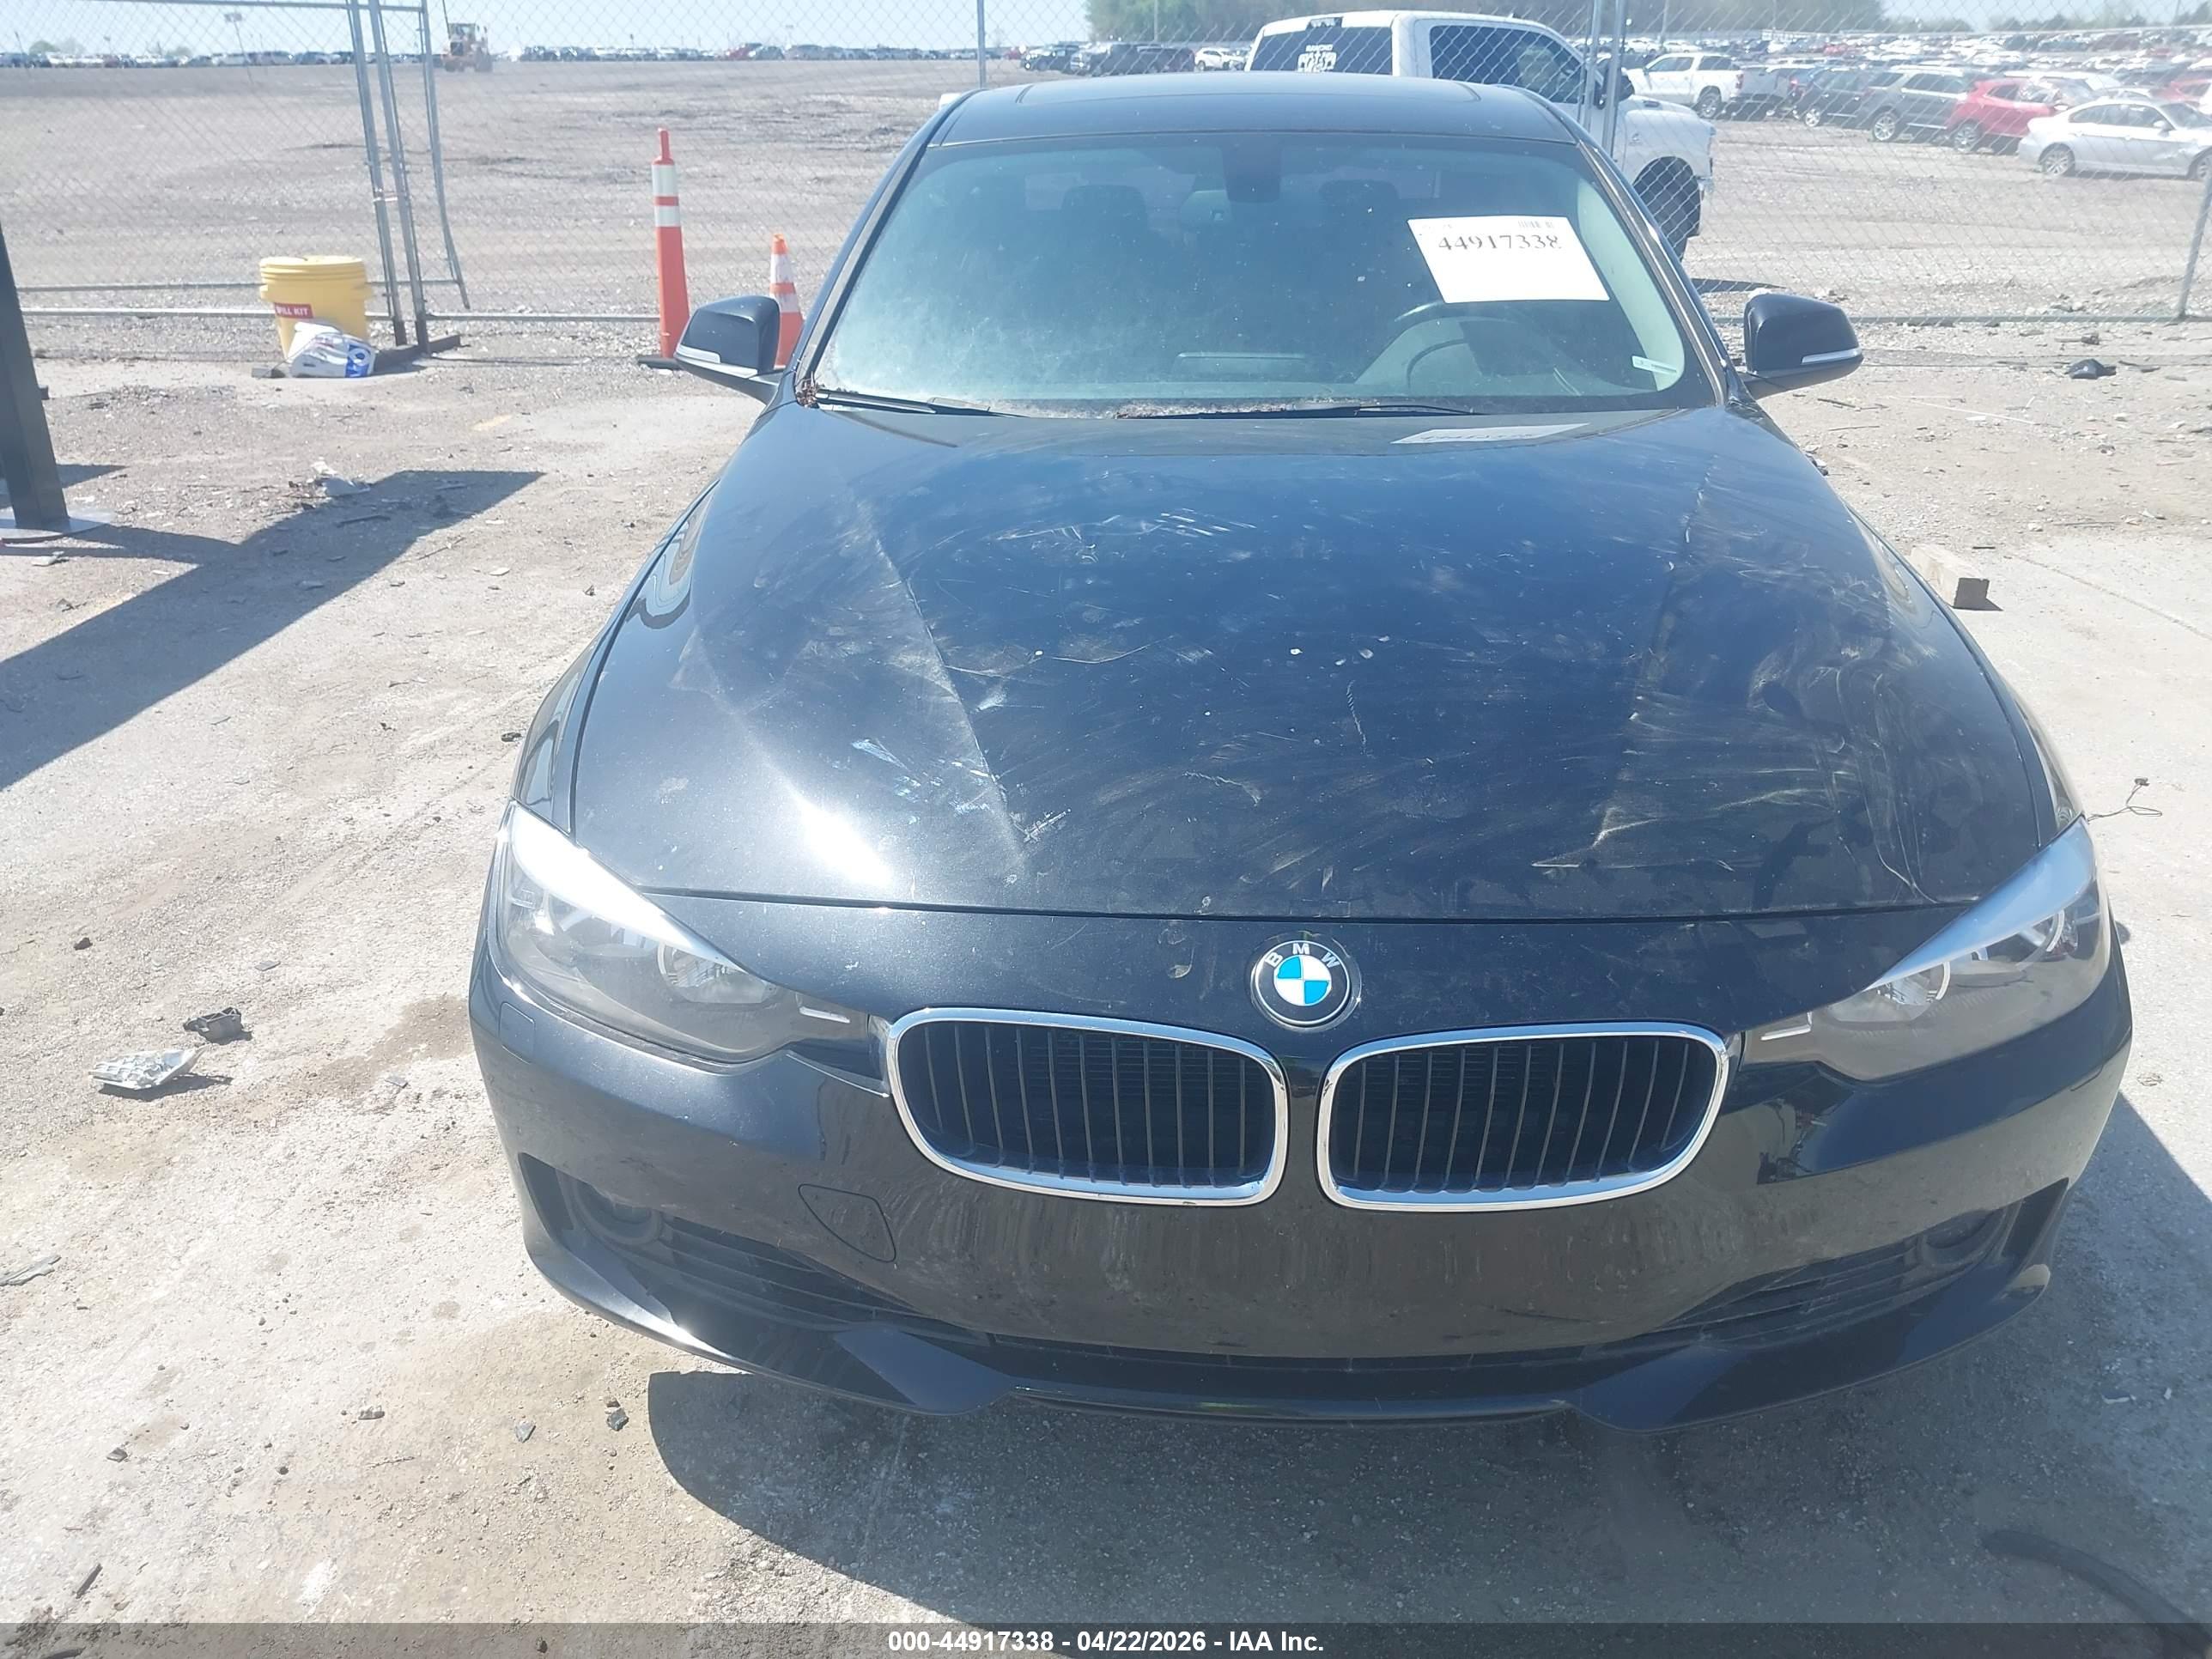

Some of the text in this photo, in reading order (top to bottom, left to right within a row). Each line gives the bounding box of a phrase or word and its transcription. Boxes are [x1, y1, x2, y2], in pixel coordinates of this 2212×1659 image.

[1438, 234, 1562, 251] 44917338
[294, 307, 308, 316] KIT
[1264, 943, 1340, 968] BMW
